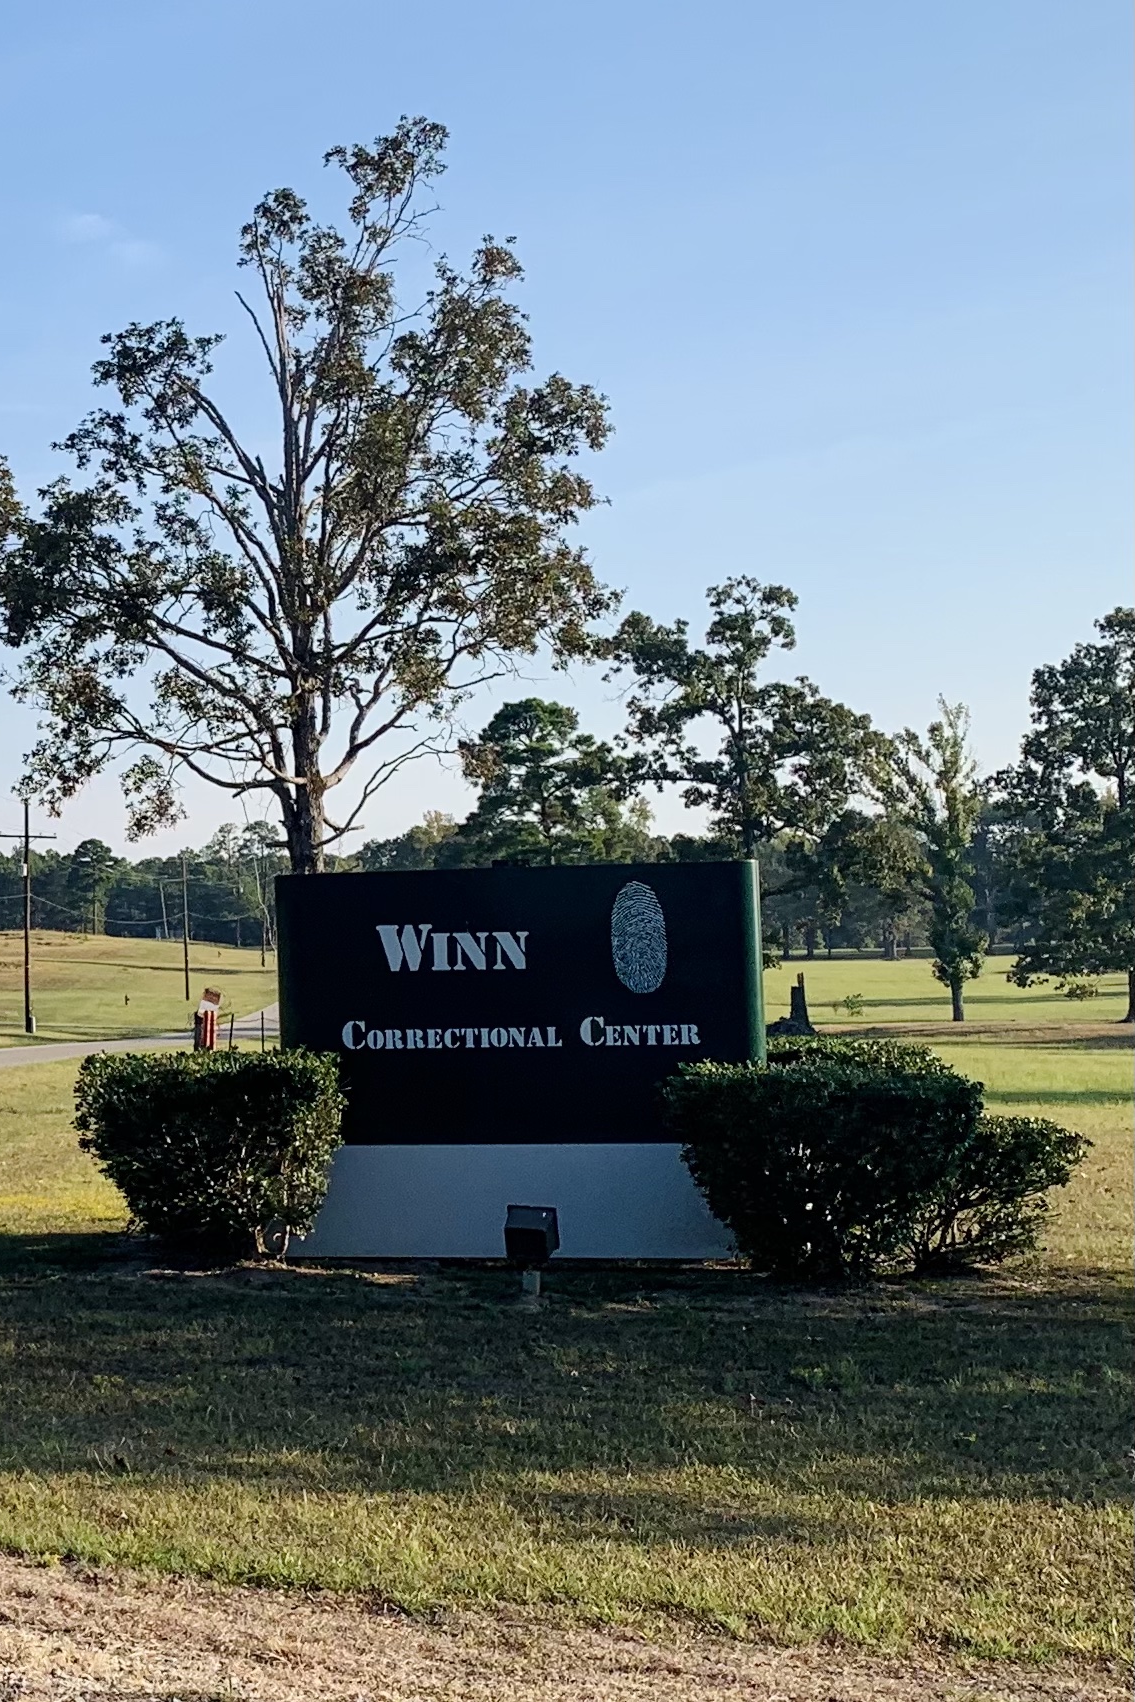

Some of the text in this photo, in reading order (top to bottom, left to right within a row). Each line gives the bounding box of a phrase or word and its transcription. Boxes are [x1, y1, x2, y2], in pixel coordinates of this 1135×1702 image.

[375, 923, 530, 972] WINN
[341, 1016, 701, 1050] CORRECTIONAL CENTER
